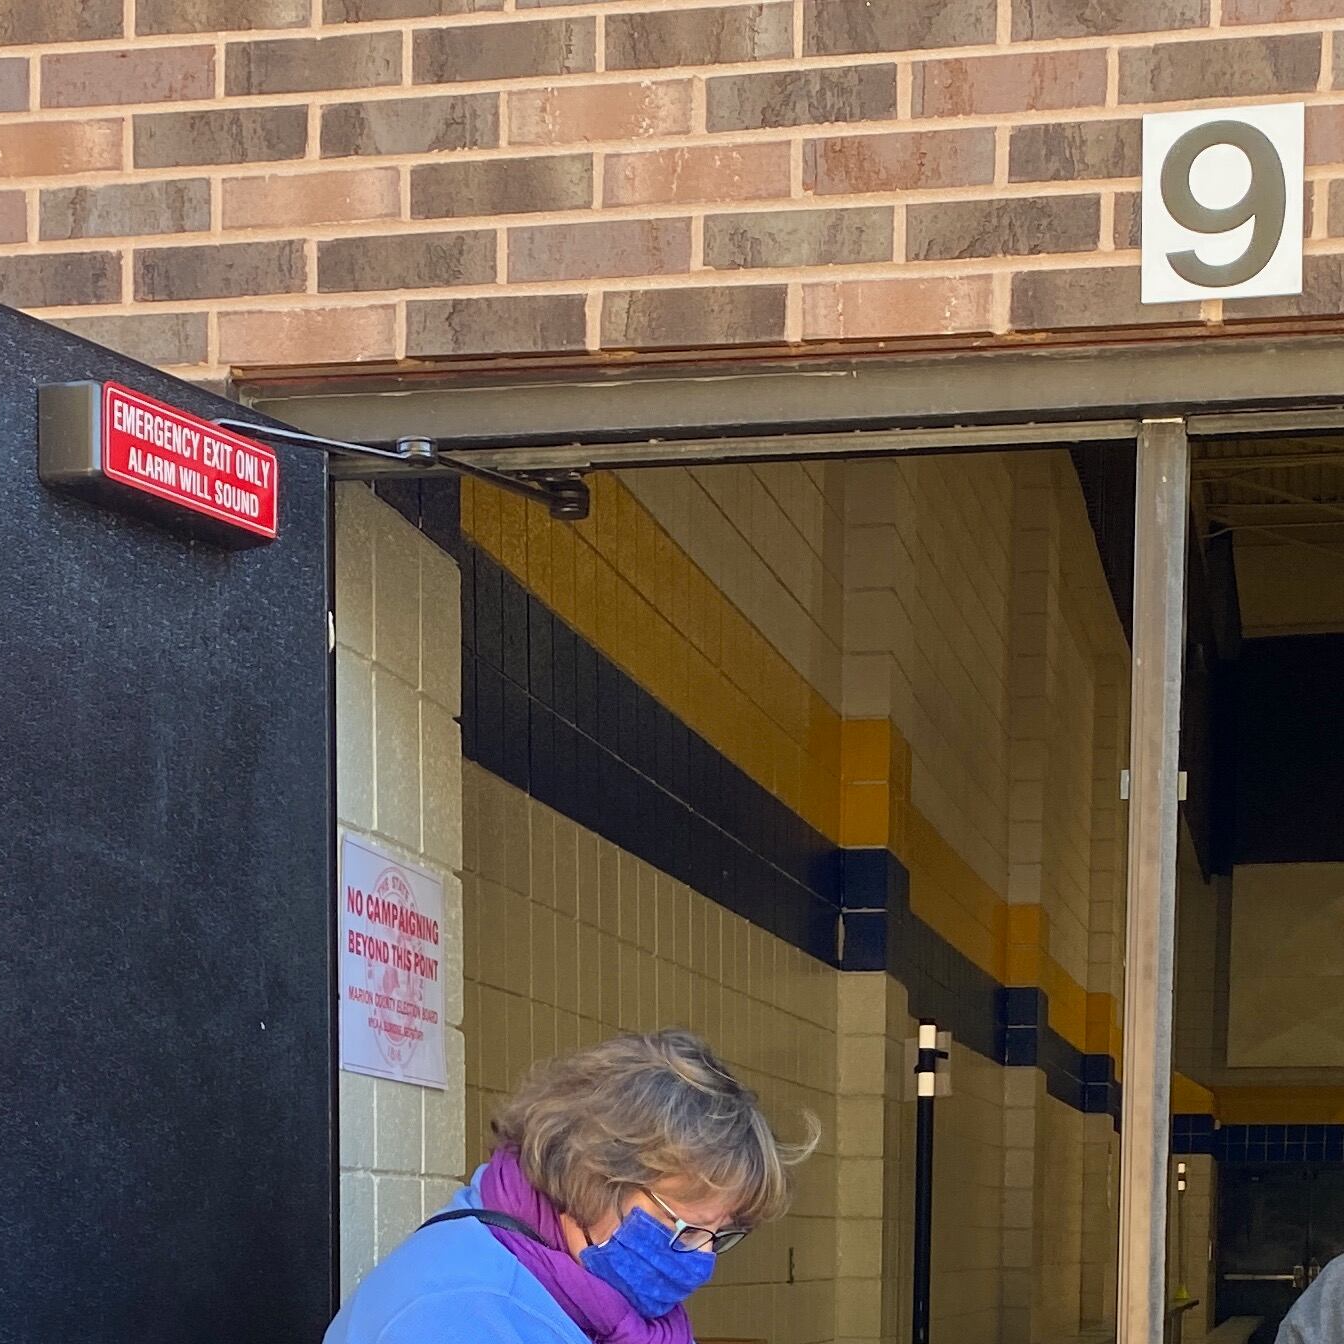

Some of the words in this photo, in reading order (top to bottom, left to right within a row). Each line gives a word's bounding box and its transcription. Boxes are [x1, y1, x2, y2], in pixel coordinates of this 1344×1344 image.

[1160, 120, 1287, 288] 9
[113, 401, 201, 460] EMERGENCY
[203, 437, 234, 472] EXIT
[235, 450, 271, 489] ONLY
[128, 447, 176, 487] ALARM
[179, 467, 212, 501] WILL
[214, 482, 259, 518] SOUND
[348, 885, 363, 917] NO
[367, 894, 439, 945] CAMPAIGNING
[348, 929, 389, 965] BEYOND
[391, 943, 413, 973] THIS
[414, 951, 439, 982] POINT
